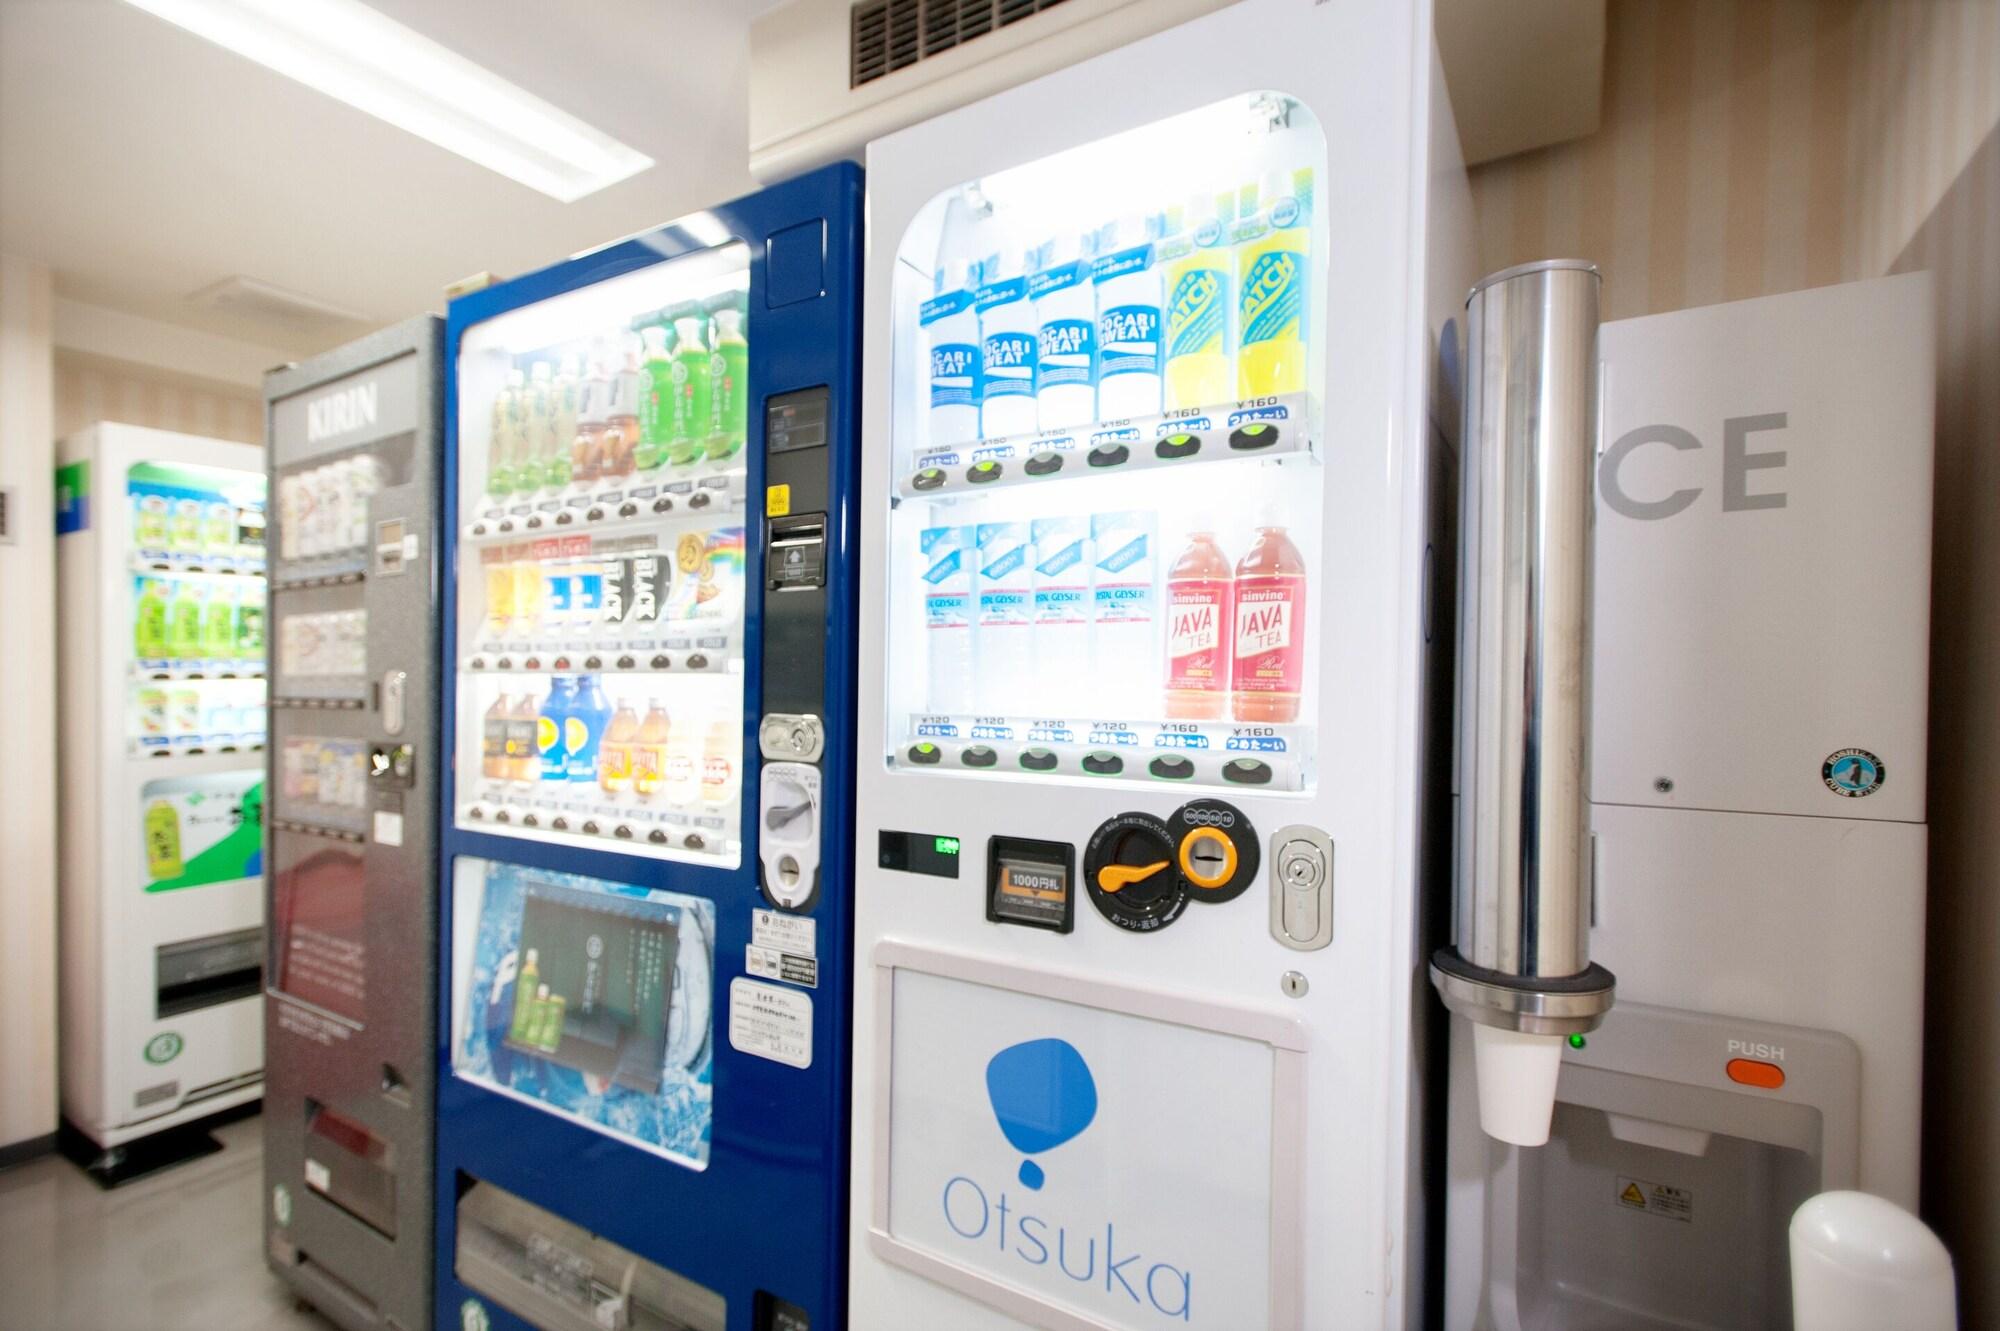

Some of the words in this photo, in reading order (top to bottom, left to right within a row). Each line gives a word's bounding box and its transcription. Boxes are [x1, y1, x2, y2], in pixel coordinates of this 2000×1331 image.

[1240, 252, 1295, 332] ATCH
[1167, 270, 1218, 338] ATCH
[307, 381, 378, 443] KIRIN
[1163, 408, 1200, 419] ¥160
[1237, 396, 1277, 411] ¥160
[1599, 411, 1787, 521] CE
[1242, 590, 1284, 602] sinvino
[1171, 606, 1212, 641] JAVA
[1240, 603, 1283, 639] JAVA
[1187, 632, 1211, 649] TEA
[1255, 630, 1282, 648] TEA
[1160, 723, 1198, 733] ¥160
[1233, 727, 1274, 737] ¥160
[1013, 874, 1060, 890] 1000円札
[1727, 1039, 1785, 1061] PUSH
[944, 1177, 1191, 1322] Otsuka
